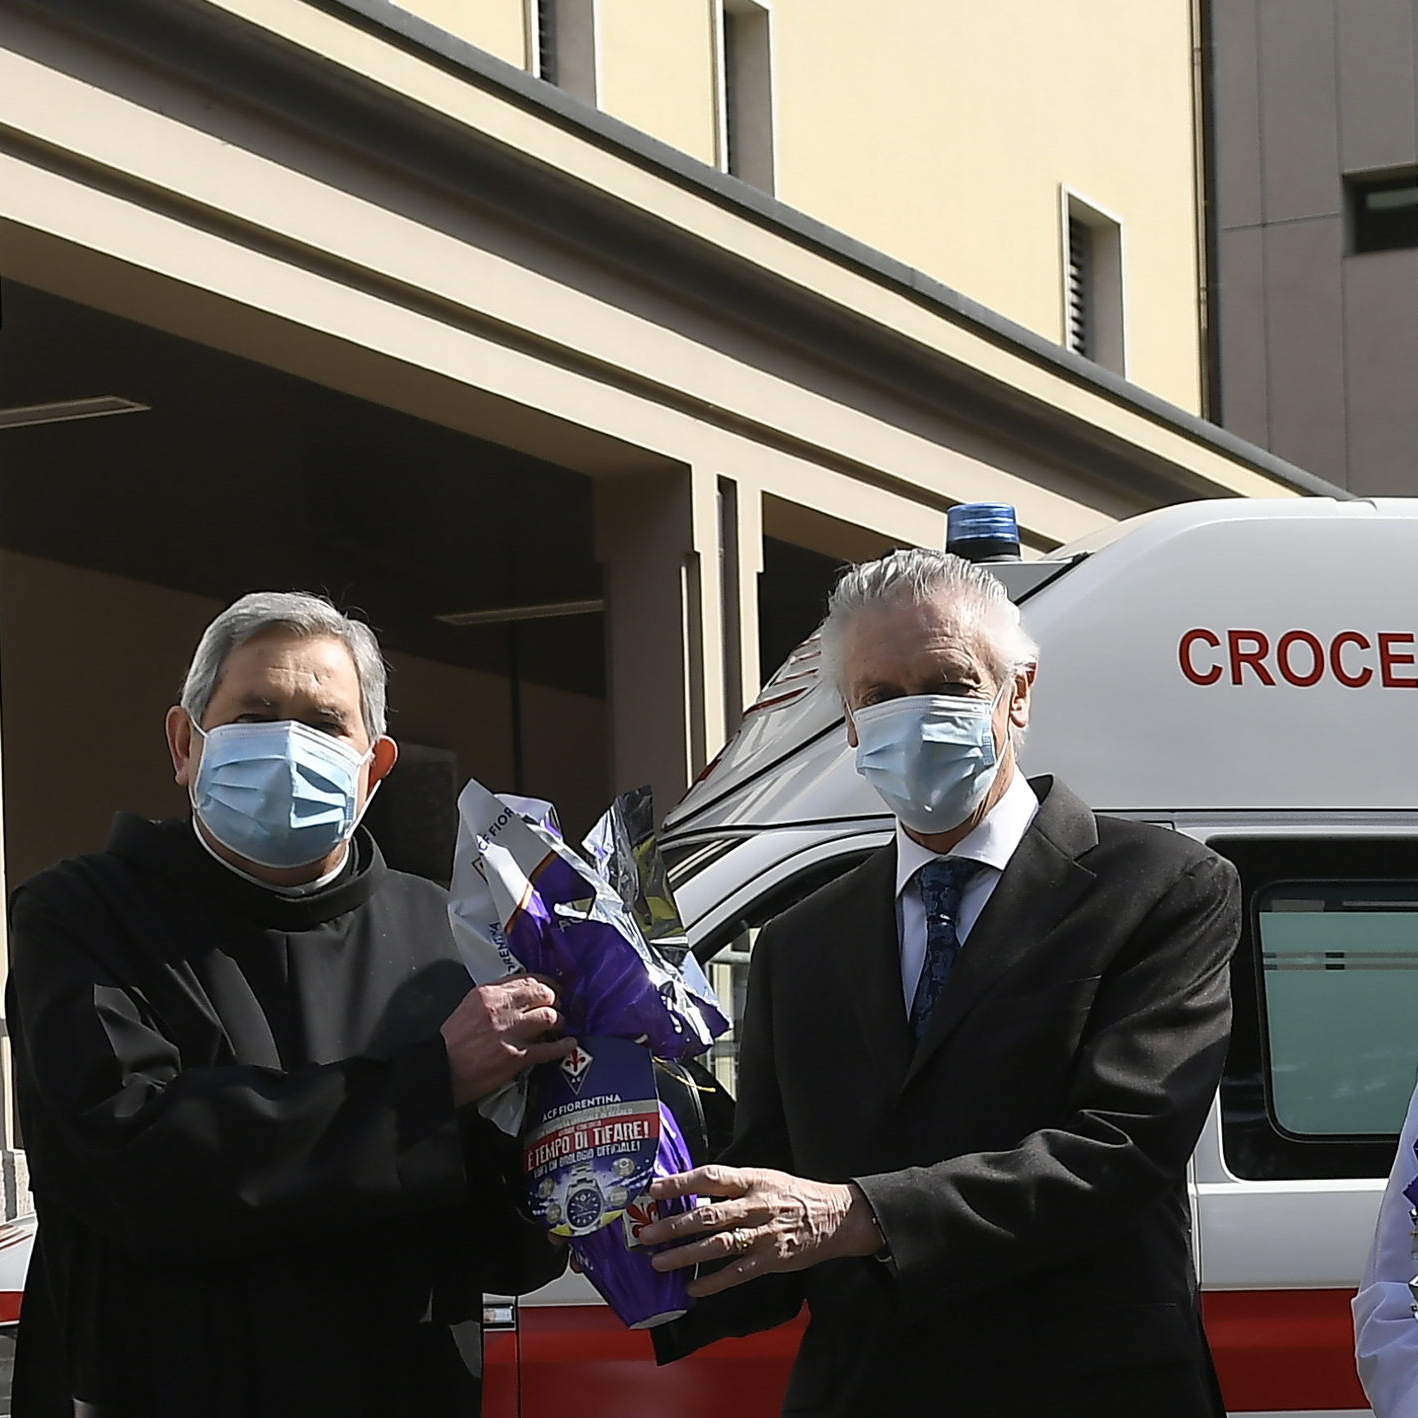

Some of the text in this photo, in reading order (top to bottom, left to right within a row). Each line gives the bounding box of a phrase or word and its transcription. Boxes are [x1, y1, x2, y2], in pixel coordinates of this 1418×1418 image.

[543, 1108, 558, 1121] ACF
[559, 1094, 622, 1113] FIORENTINA
[528, 1150, 535, 1171] È
[535, 1136, 570, 1166] TEMPO
[575, 1132, 588, 1150] DI
[593, 1120, 649, 1146] TIFARE!
